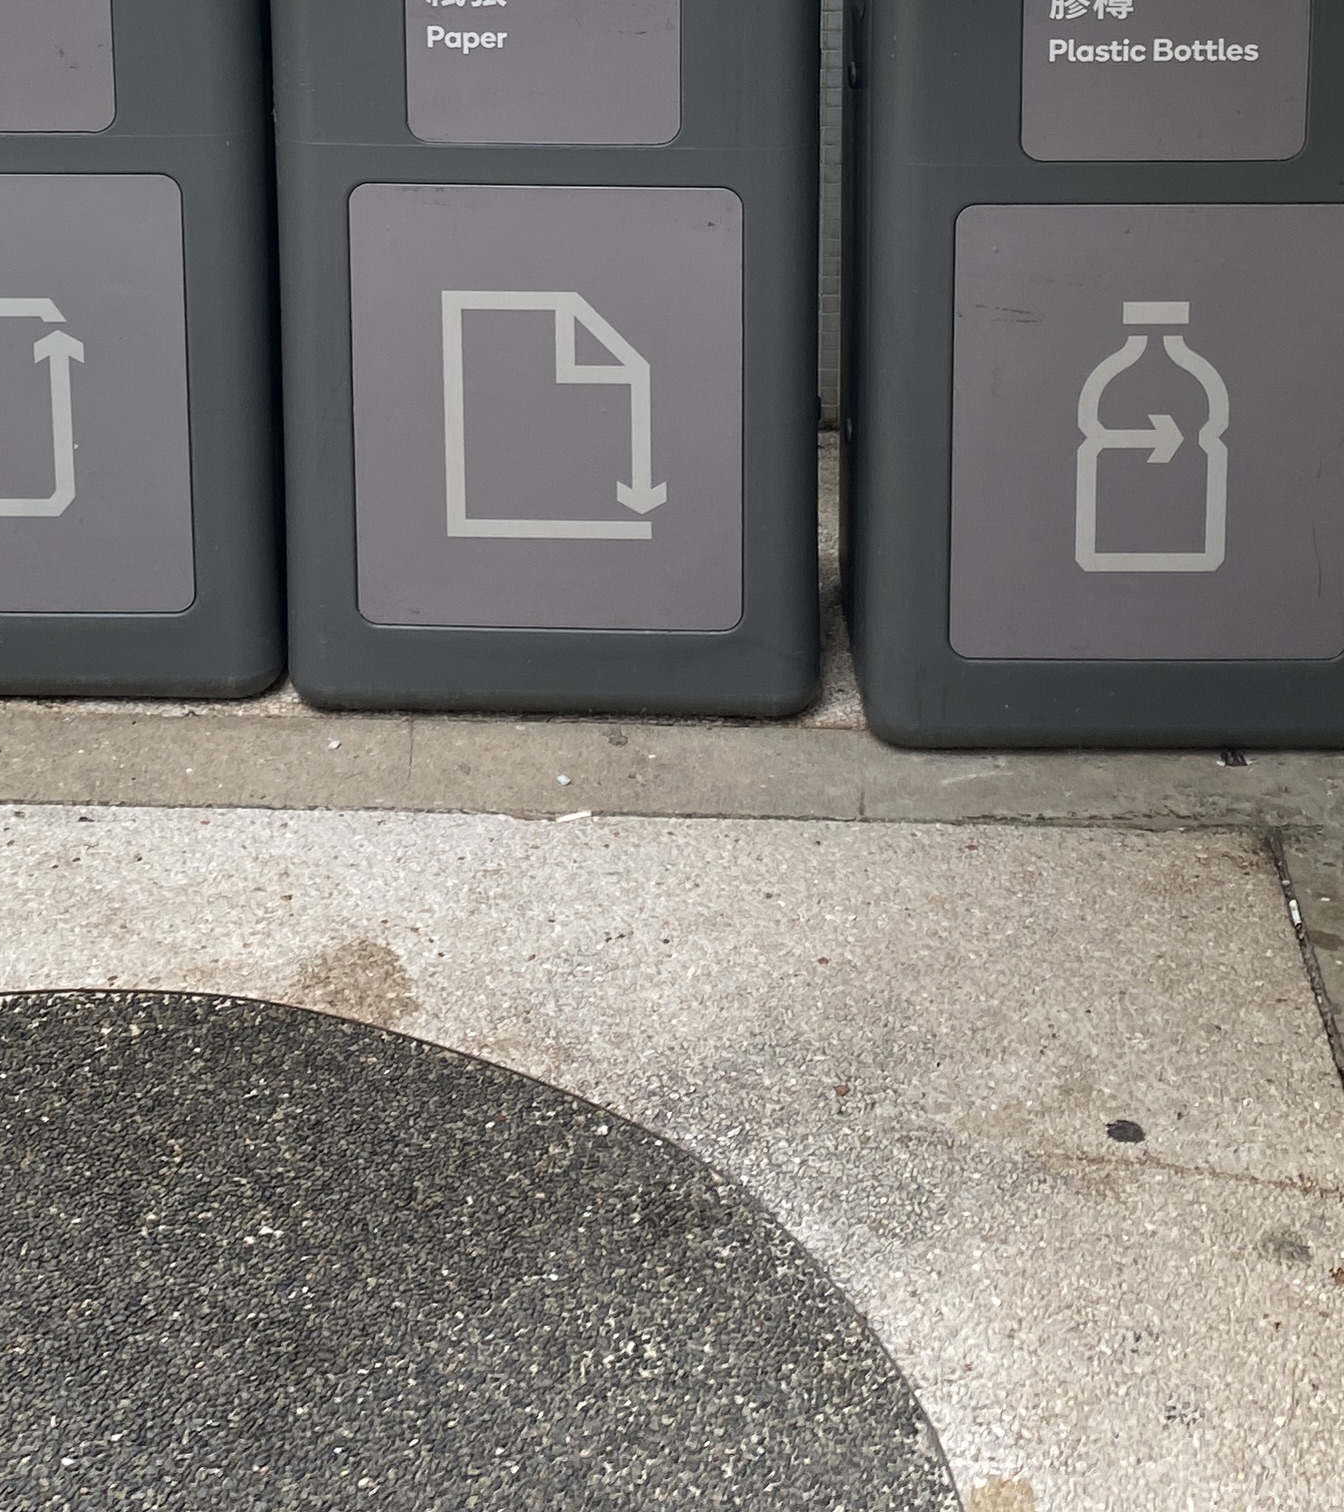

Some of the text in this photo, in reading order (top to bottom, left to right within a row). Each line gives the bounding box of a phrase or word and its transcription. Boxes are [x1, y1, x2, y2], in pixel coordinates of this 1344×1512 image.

[426, 25, 508, 54] Paper
[1049, 38, 1260, 63] Plastic Bottles
